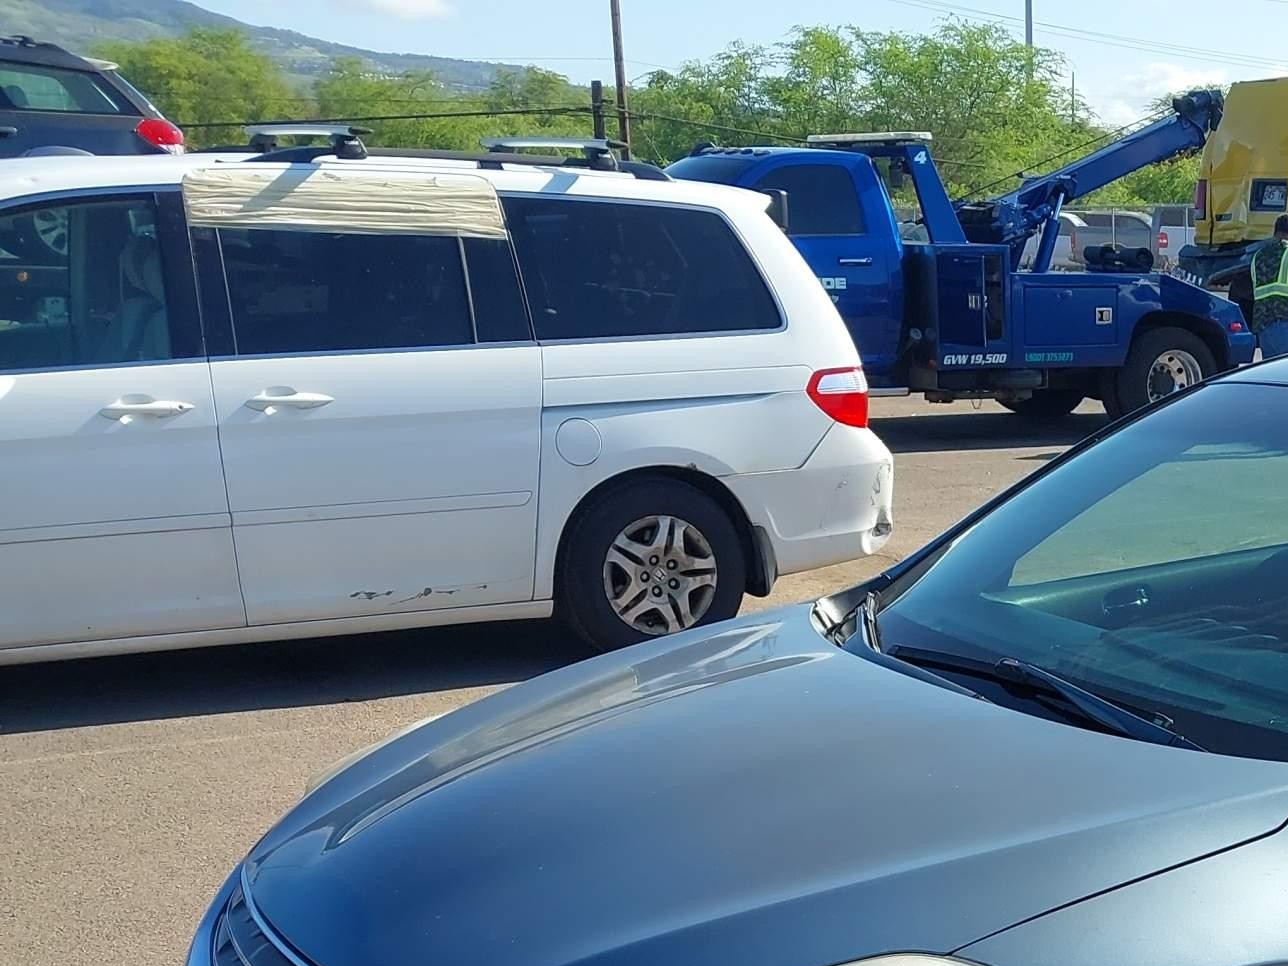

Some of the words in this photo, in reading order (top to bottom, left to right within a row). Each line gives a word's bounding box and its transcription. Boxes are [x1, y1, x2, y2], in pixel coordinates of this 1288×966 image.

[821, 277, 847, 290] DE
[943, 354, 968, 365] GVW
[970, 353, 1007, 366] 19,500
